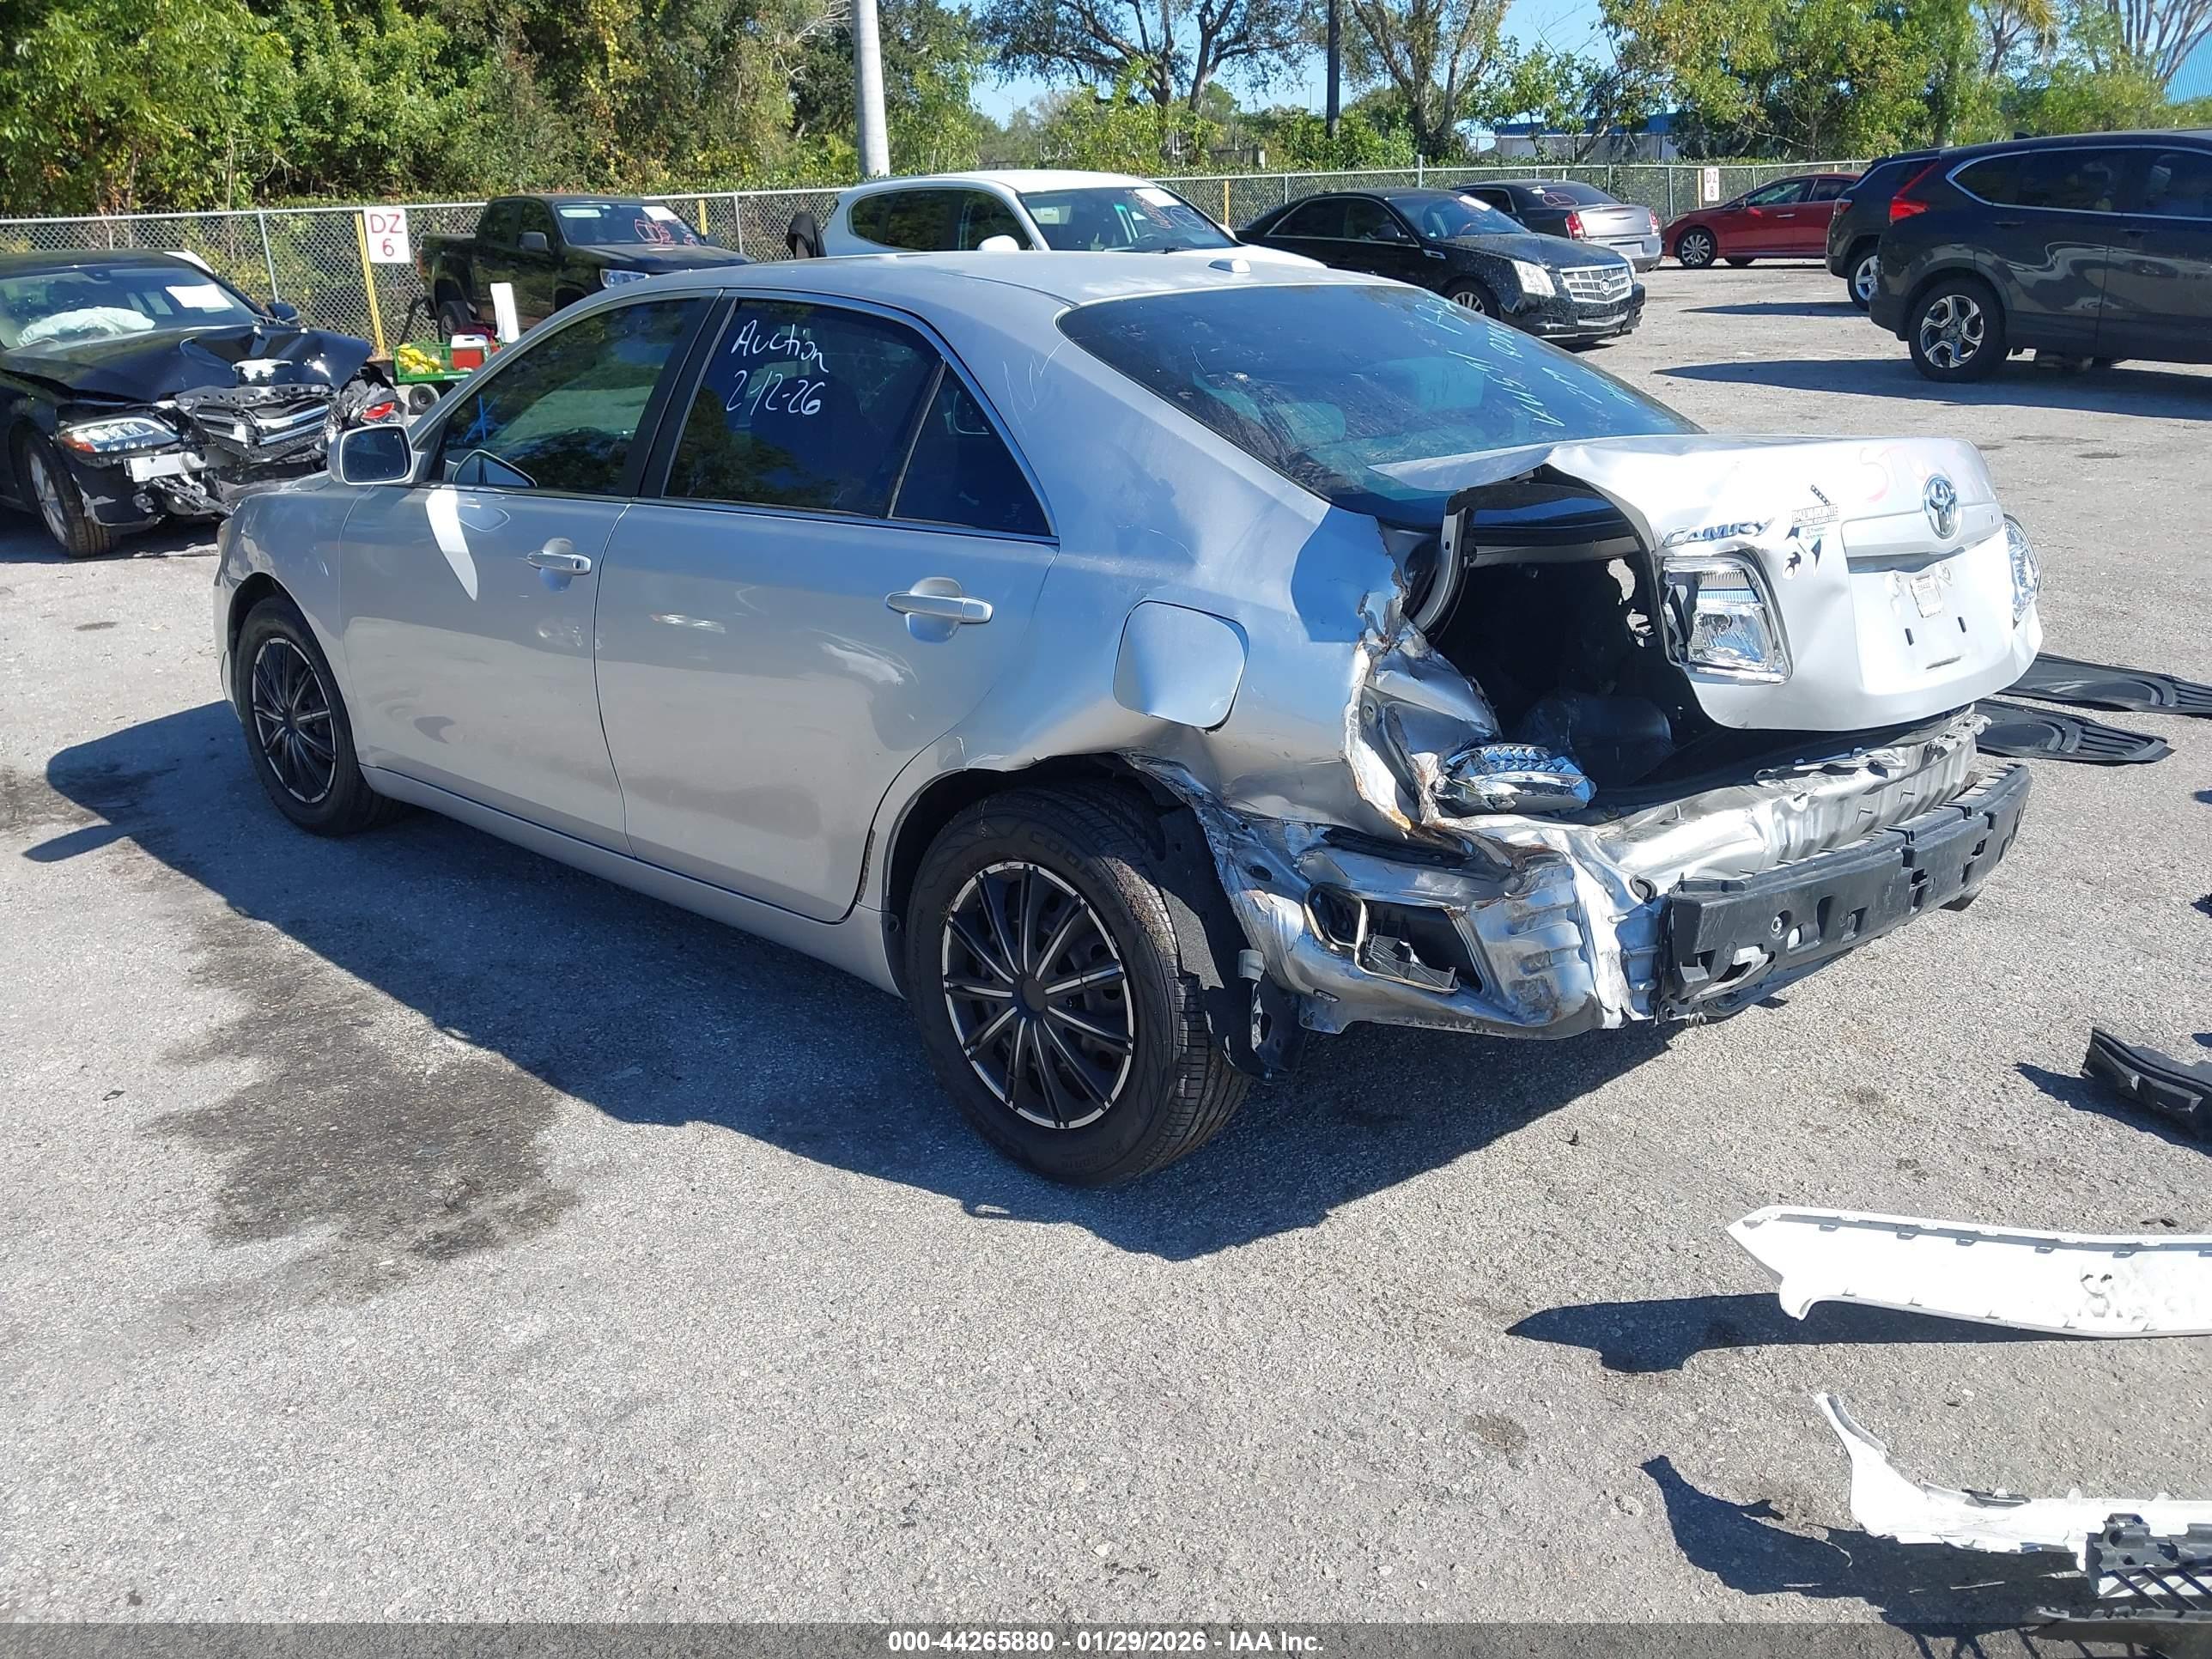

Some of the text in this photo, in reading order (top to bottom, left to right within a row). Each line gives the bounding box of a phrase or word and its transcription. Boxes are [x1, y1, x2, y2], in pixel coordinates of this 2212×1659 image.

[1705, 171, 1718, 183] DZ
[1709, 185, 1716, 198] 8
[369, 213, 404, 234] DZ
[381, 237, 395, 258] 6
[730, 319, 830, 374] Auction
[726, 369, 826, 416] 2-12-26
[1662, 517, 1776, 549] CAMRY
